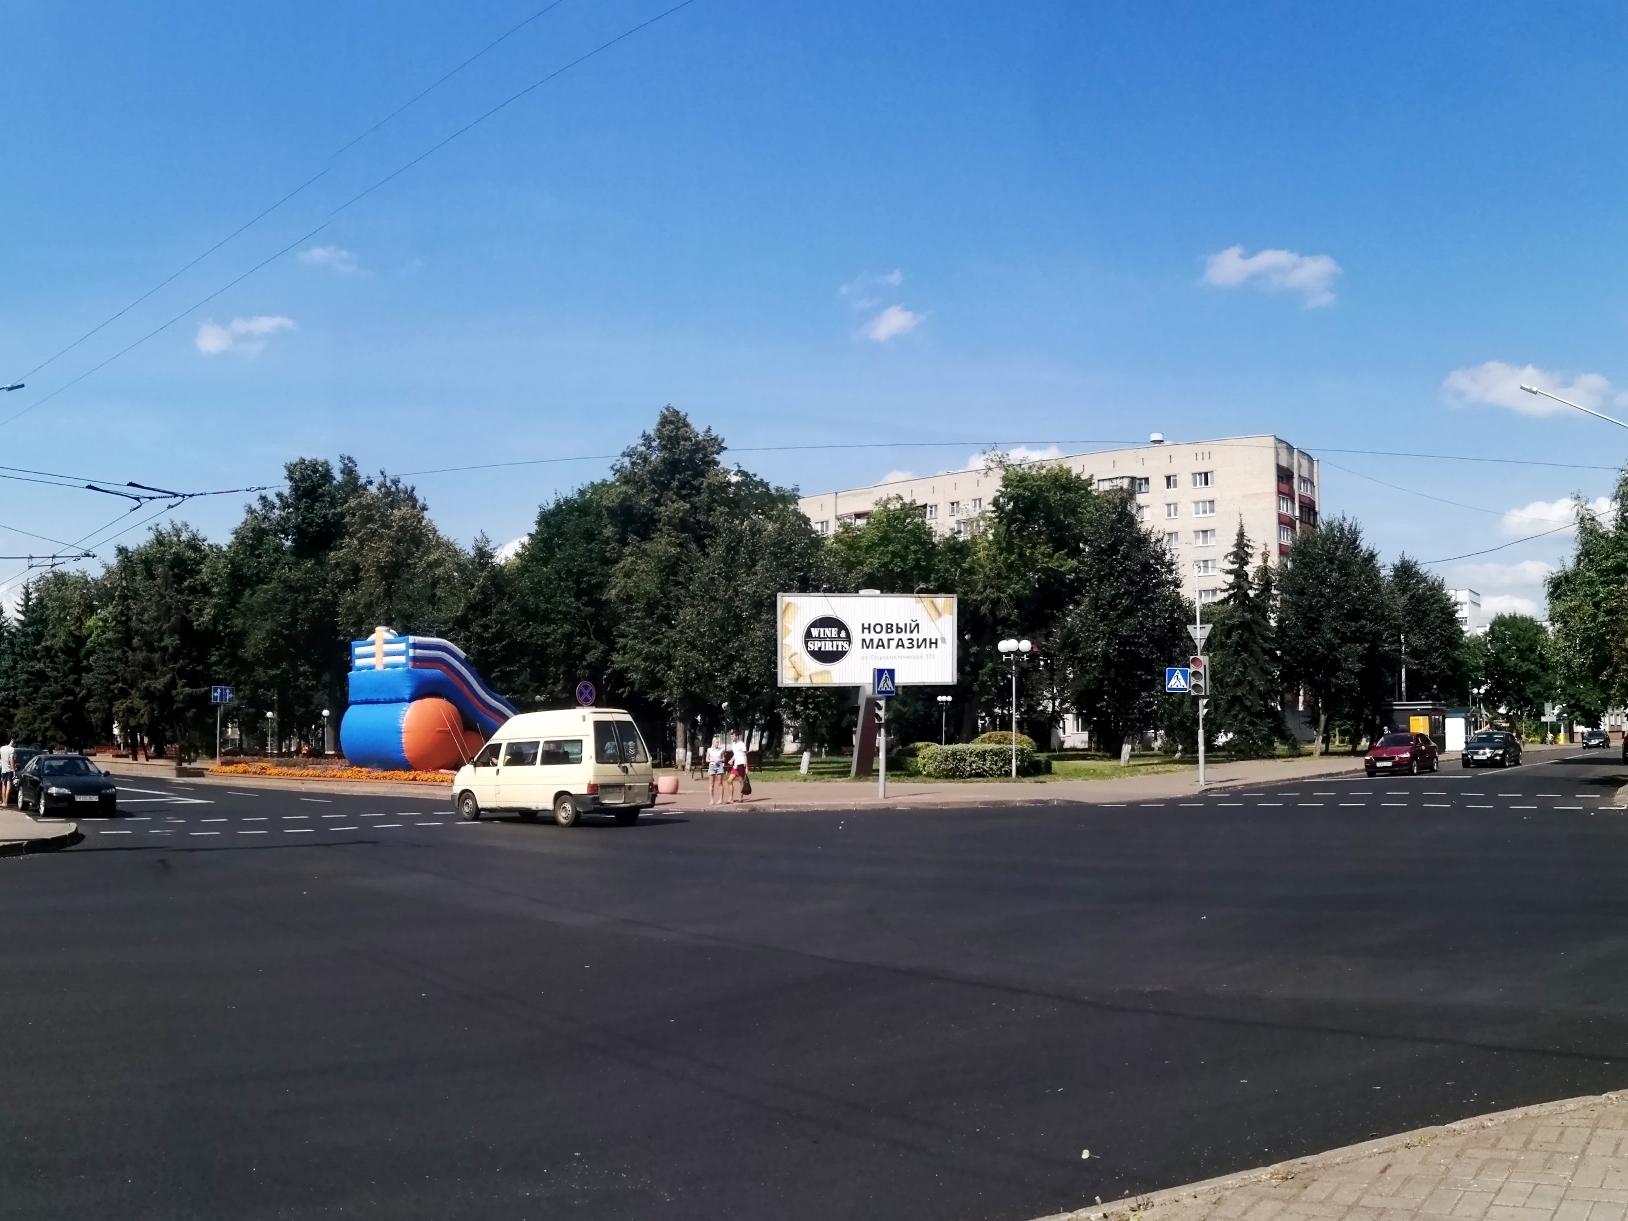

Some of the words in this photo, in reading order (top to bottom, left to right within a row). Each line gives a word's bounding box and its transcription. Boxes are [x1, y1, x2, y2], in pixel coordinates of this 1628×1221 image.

[861, 619, 920, 634] НОВЫЙ
[810, 628, 838, 638] WINE
[839, 629, 847, 638] &
[807, 641, 849, 652] SPIRITS
[861, 638, 938, 650] МАГАЗИН
